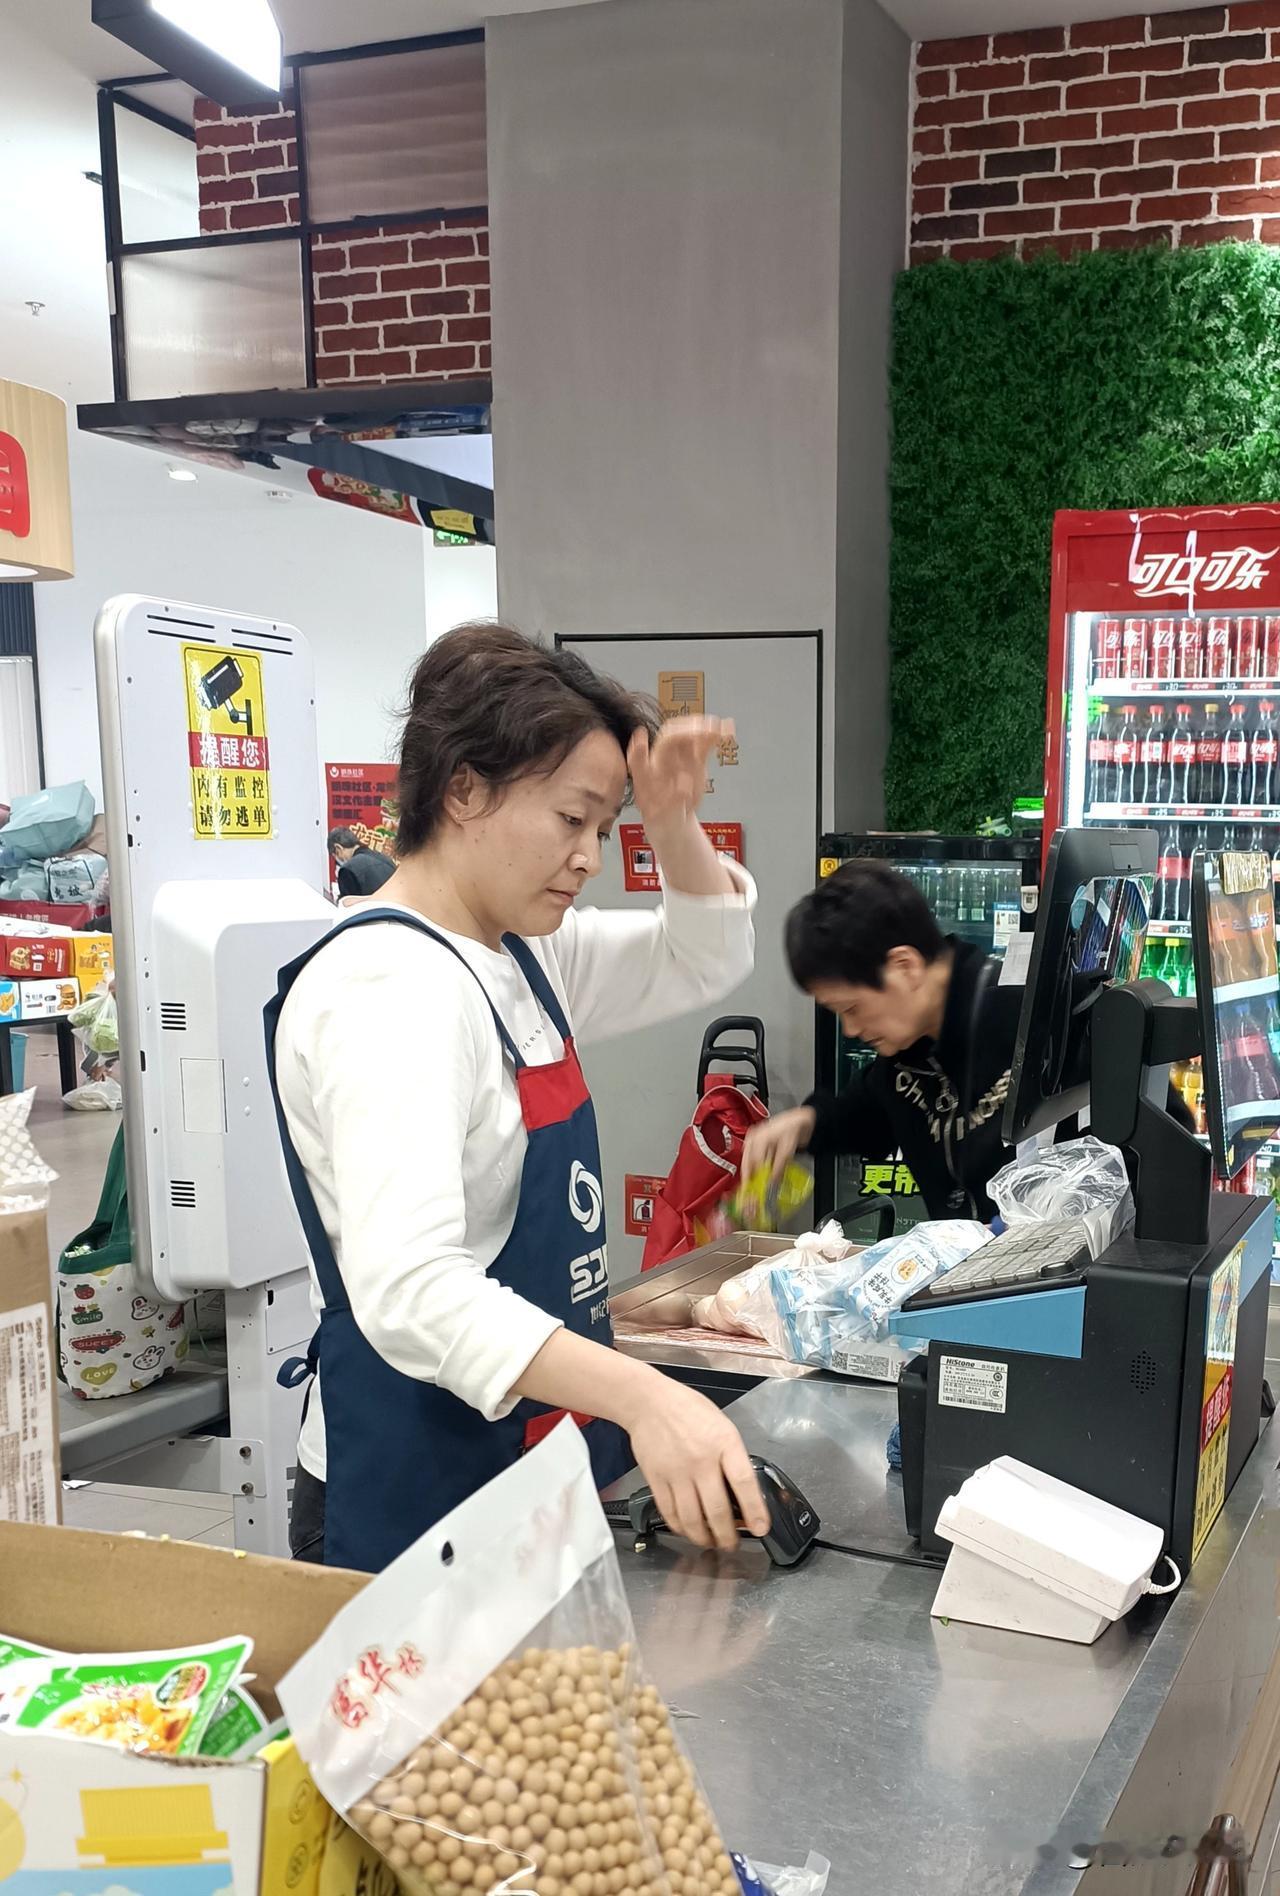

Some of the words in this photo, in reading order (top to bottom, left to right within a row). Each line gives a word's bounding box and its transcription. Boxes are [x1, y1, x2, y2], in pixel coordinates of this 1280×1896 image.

[1133, 546, 1280, 598] 可口可乐
[198, 735, 260, 768] 提醒您
[197, 773, 265, 799] 内有监控
[199, 804, 267, 828] 请勿逃单
[86, 1366, 115, 1380] LOVE
